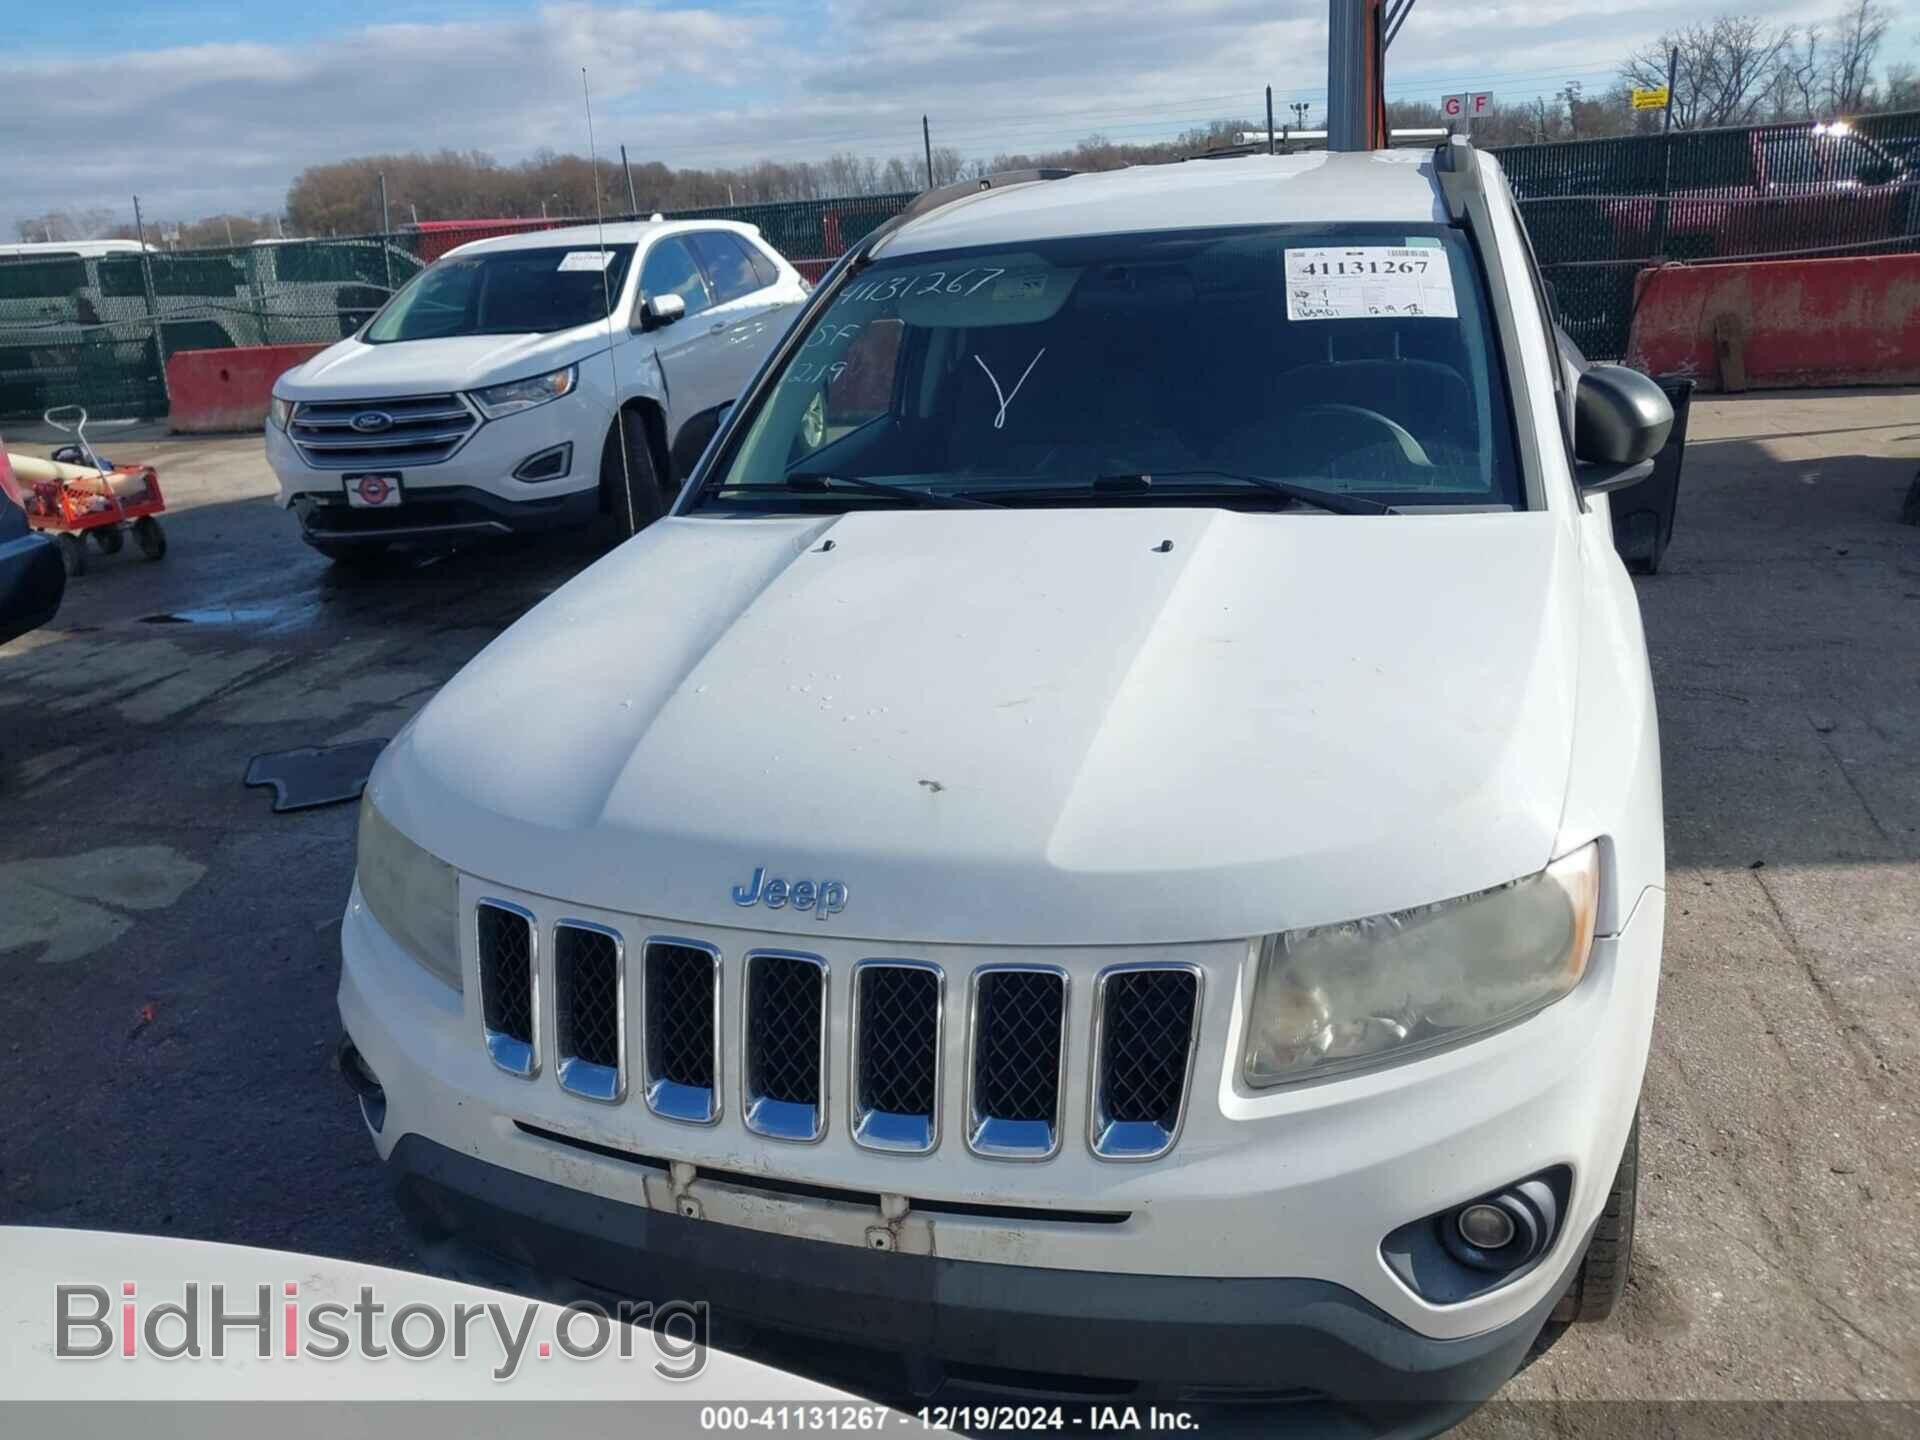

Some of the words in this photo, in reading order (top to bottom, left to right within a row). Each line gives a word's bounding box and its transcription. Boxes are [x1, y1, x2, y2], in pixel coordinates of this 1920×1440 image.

[1446, 98, 1460, 115] G
[1475, 96, 1487, 112] F
[1302, 261, 1428, 275] 41131267
[839, 268, 1005, 304] 41131267
[732, 867, 849, 921] Jeep
